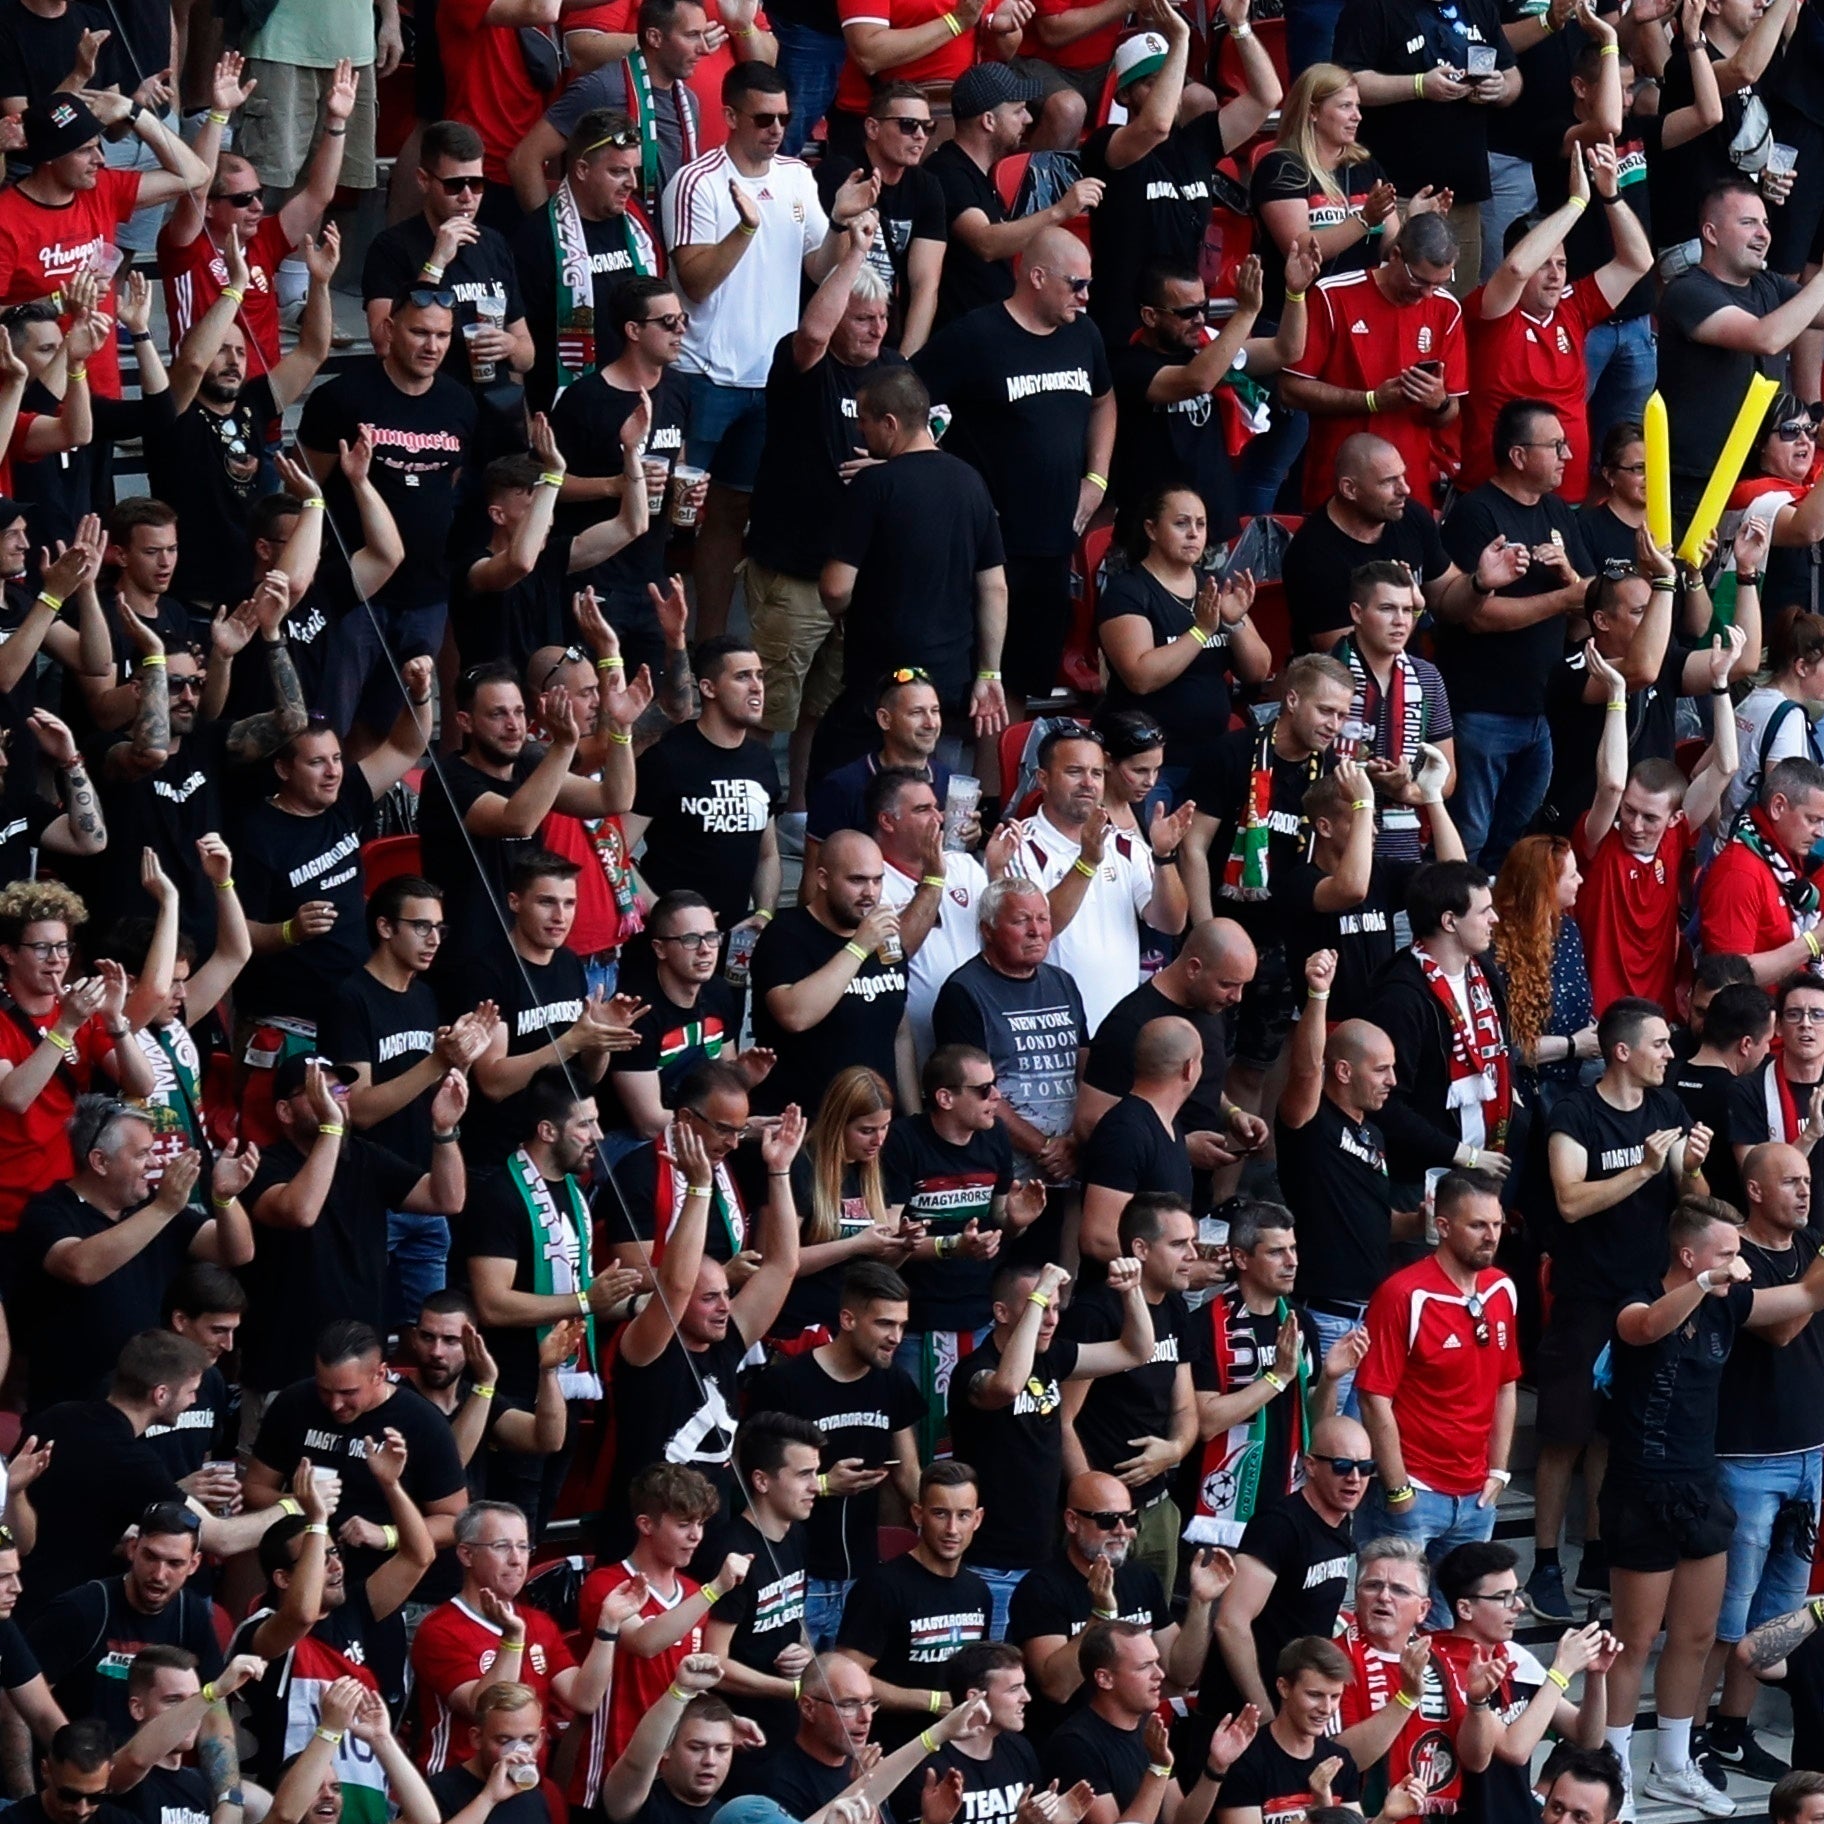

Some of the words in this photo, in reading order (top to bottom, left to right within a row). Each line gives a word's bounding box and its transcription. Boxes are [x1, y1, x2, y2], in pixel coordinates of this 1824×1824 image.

[1006, 367, 1092, 402] MAGYARORSZÁG
[711, 780, 741, 797] THE
[681, 798, 747, 815] NORTH
[702, 815, 747, 833] FACE
[1008, 1014, 1040, 1032] NEW
[1041, 1010, 1074, 1028] YORK
[1014, 1029, 1077, 1052] LONDON
